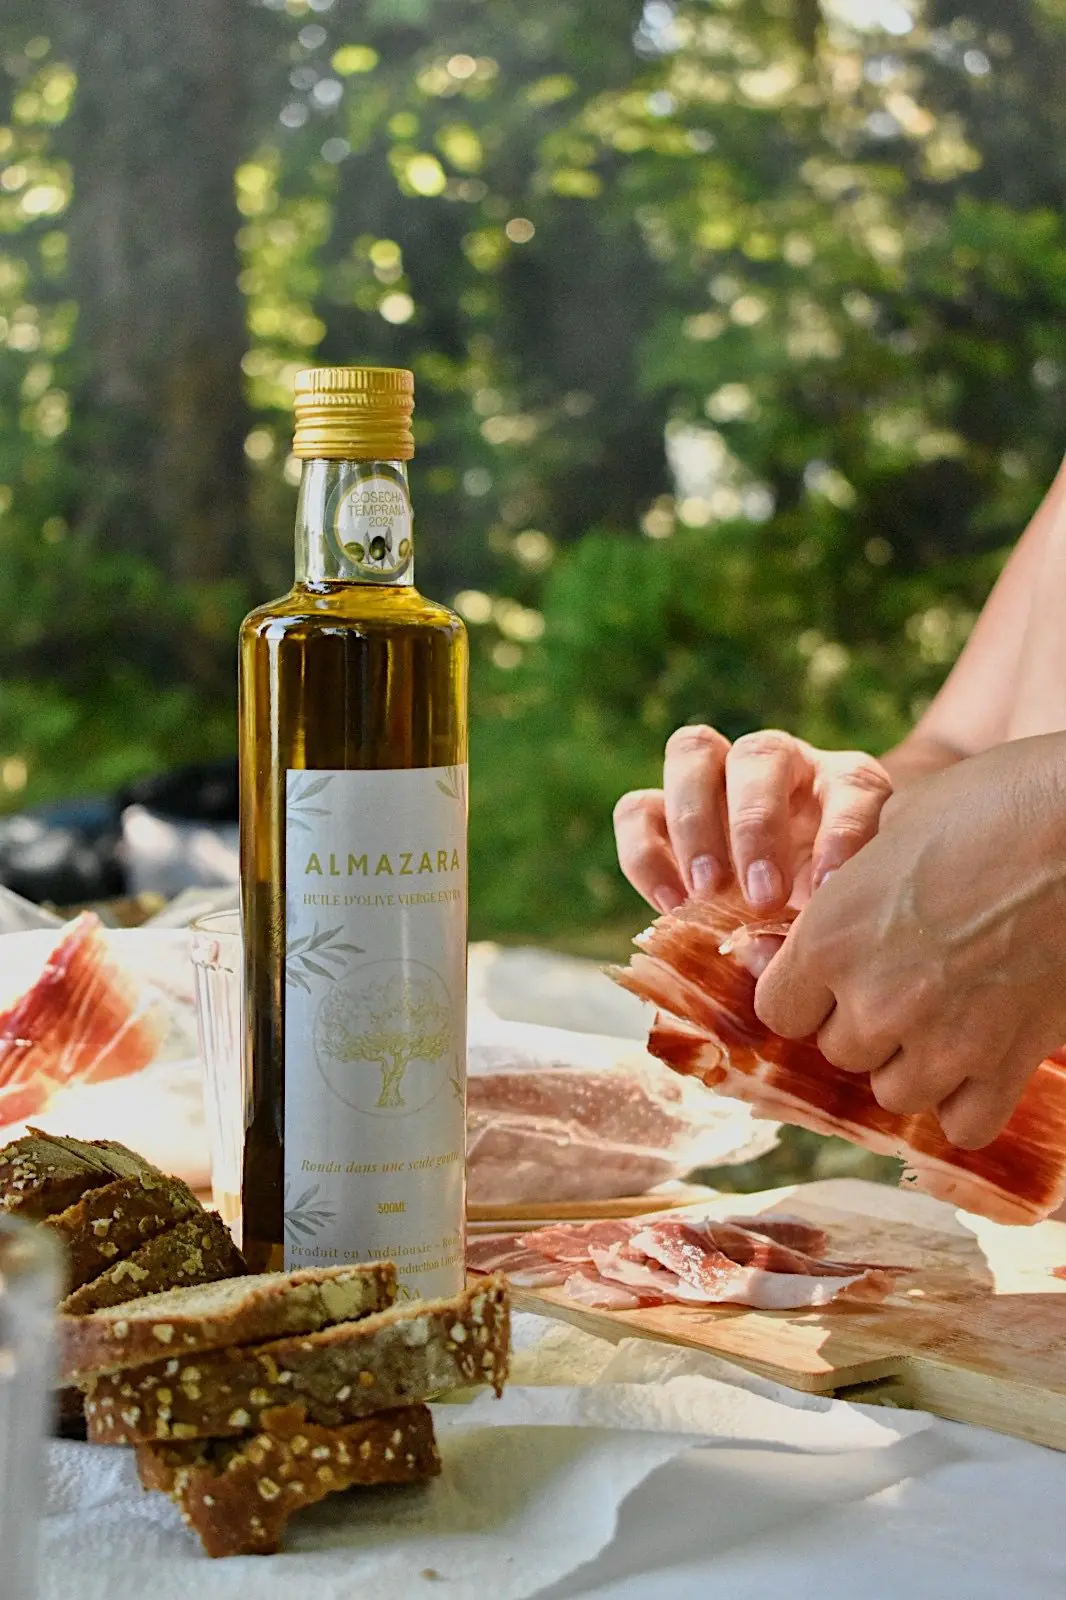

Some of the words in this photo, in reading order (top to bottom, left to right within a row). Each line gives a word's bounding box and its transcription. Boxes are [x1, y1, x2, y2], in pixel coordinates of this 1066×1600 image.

[350, 491, 403, 503] COSECHA
[368, 516, 394, 527] 2024
[305, 849, 460, 876] ALMAZARA
[303, 893, 341, 906] HUILE
[344, 894, 396, 906] D'OLIVE
[398, 892, 437, 905] VIERGE
[301, 1159, 341, 1173] Ronda
[345, 1160, 377, 1174] dans
[381, 1161, 405, 1172] une
[376, 1202, 406, 1214] 500ML
[291, 1244, 338, 1258] Produit
[343, 1249, 359, 1259] en
[366, 1244, 432, 1259] Andalousie
[399, 1259, 439, 1275] oduction
